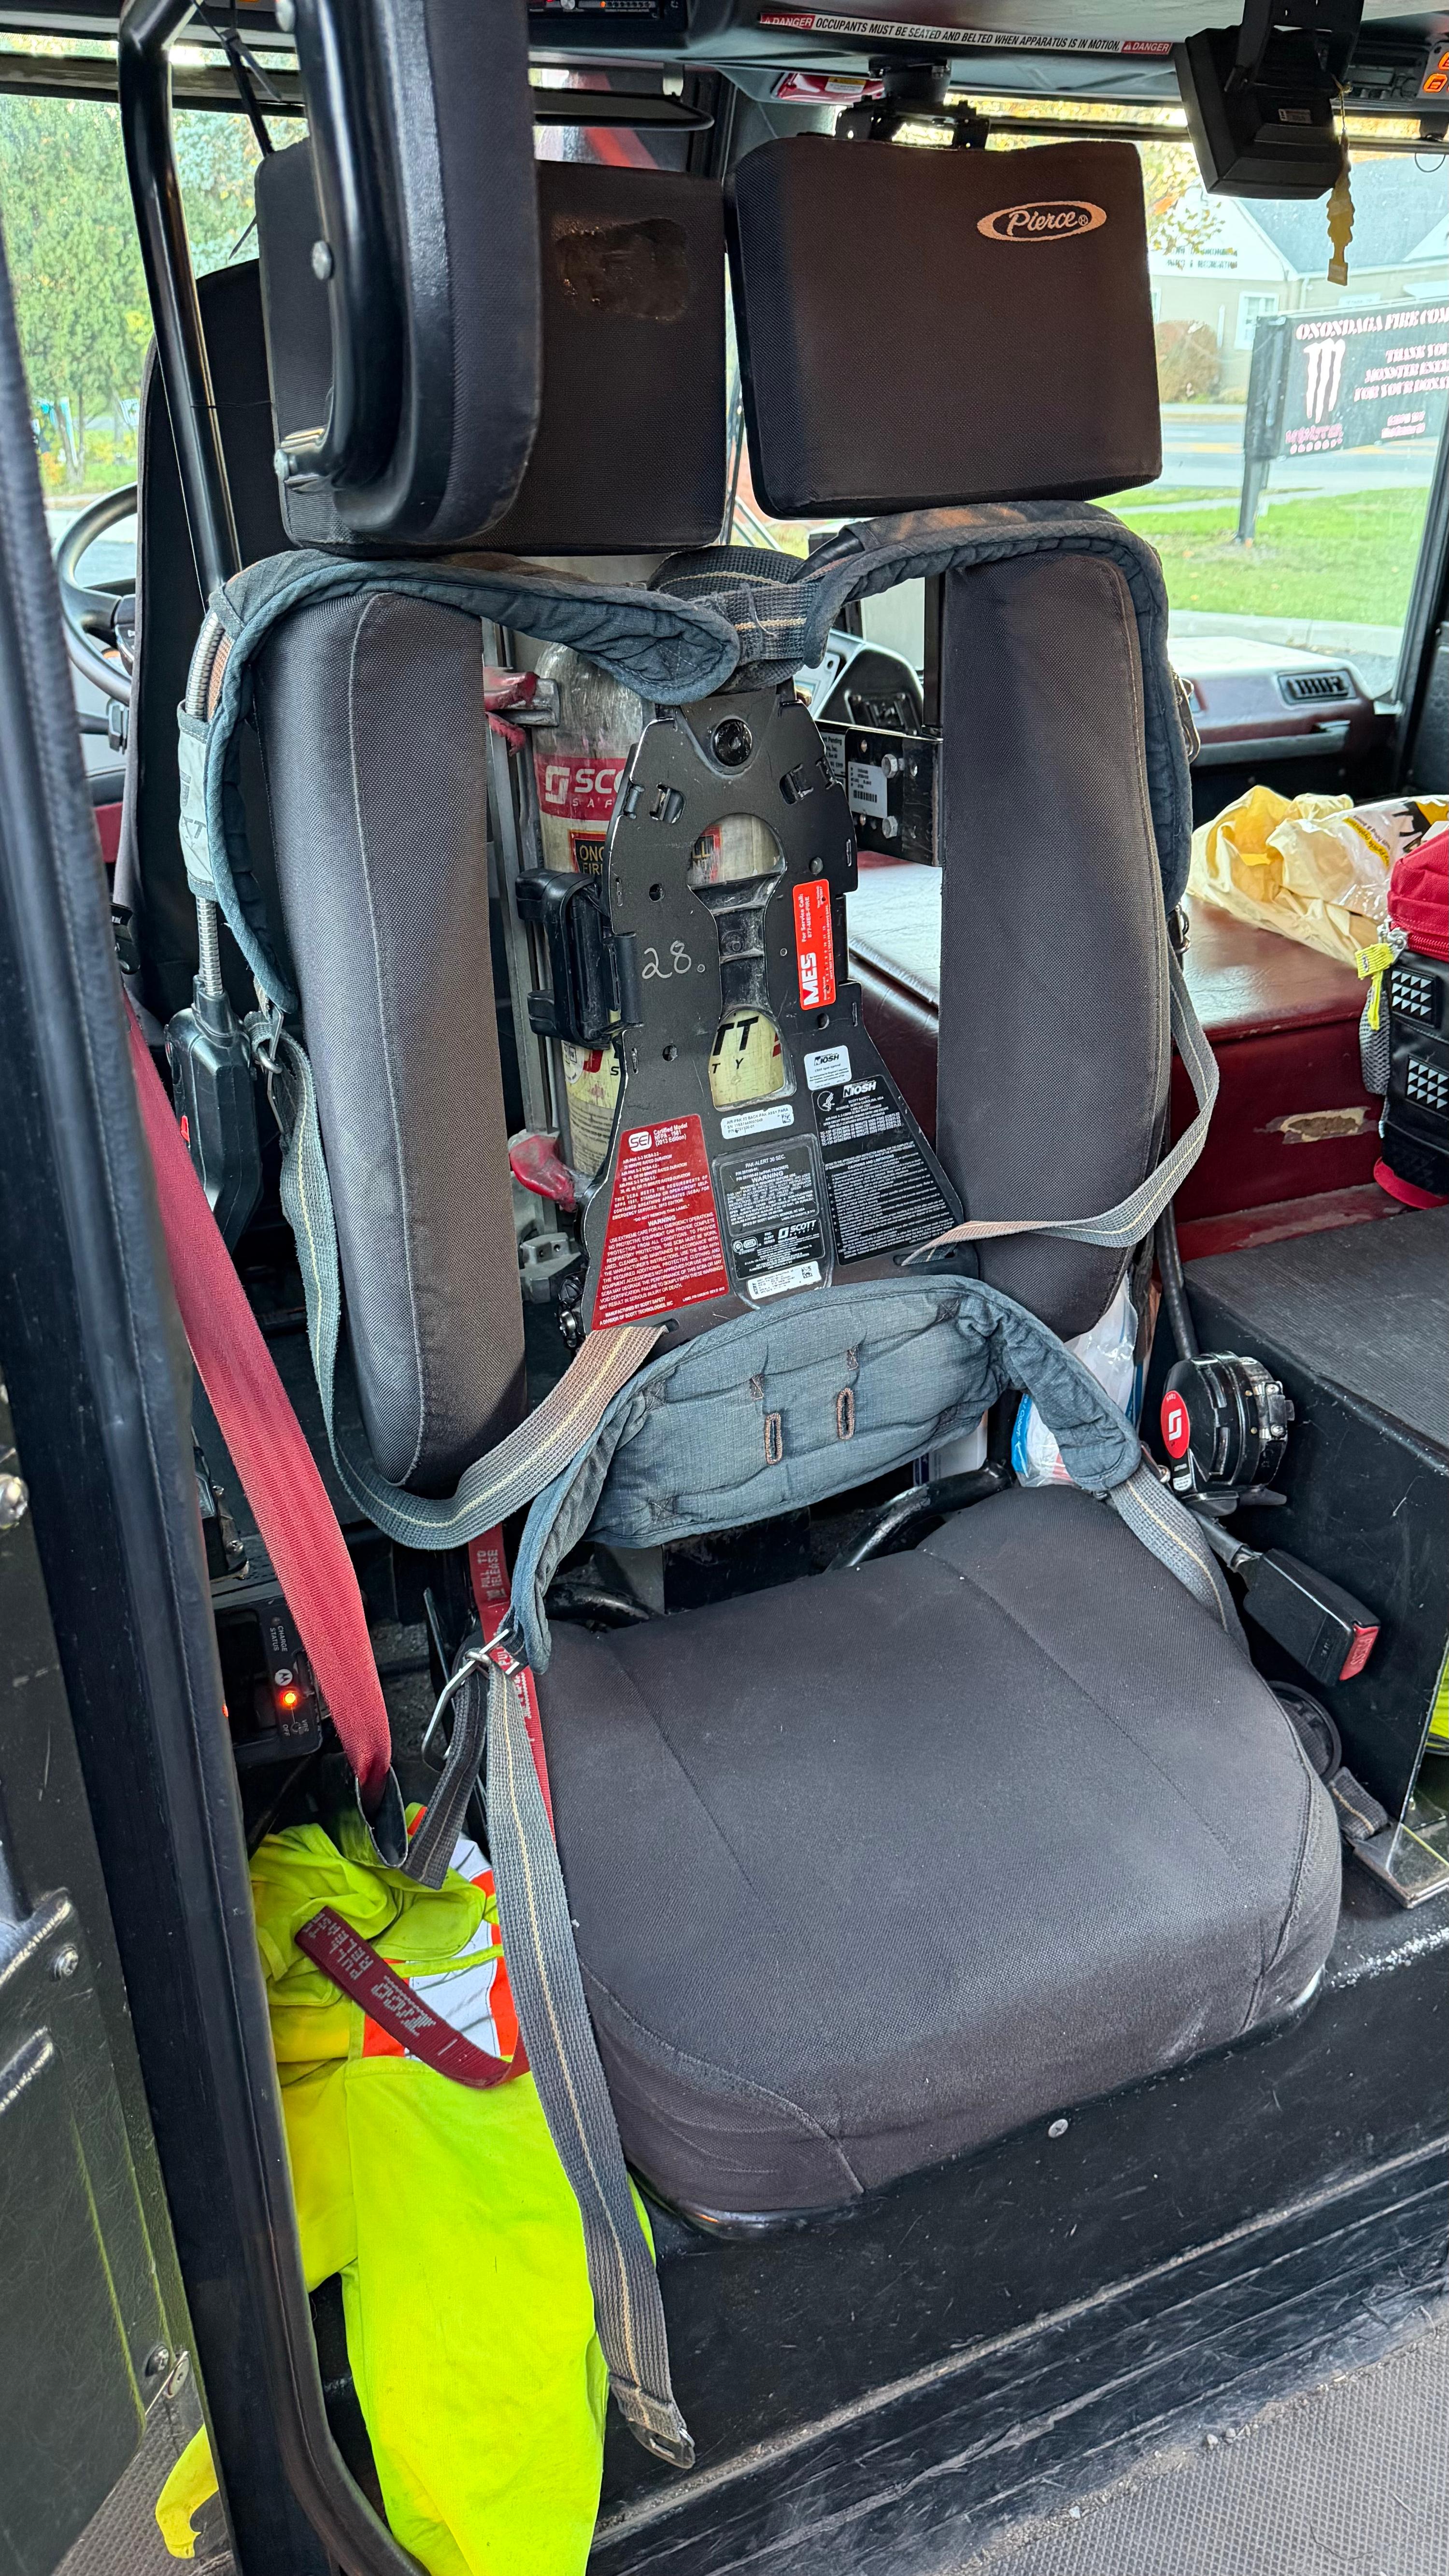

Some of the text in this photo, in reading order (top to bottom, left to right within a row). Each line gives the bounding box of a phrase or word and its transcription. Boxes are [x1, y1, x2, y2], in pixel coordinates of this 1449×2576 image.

[772, 17, 811, 27] DANGER
[816, 18, 867, 32] OCCUPANTS
[868, 24, 894, 35] MUST
[895, 26, 907, 36] BE
[908, 27, 941, 39] SEATED
[942, 31, 960, 41] AND
[961, 33, 993, 43] BELTED
[994, 35, 1018, 44] WHEN
[1019, 36, 1068, 47] APPARATUS
[1068, 39, 1076, 47] IS
[1079, 39, 1087, 48] IN
[1130, 40, 1169, 53] DANGER
[1296, 316, 1383, 340] ONONDAGA
[1385, 311, 1420, 330] FIRE
[800, 953, 819, 1006] MES
[843, 1081, 876, 1097] NIOSH
[673, 1122, 688, 1130] Model
[752, 1171, 783, 1183] WARNING
[648, 1215, 676, 1226] WARNING
[790, 1220, 816, 1233] SCOTT
[270, 1627, 279, 1651] STATUS
[278, 1625, 287, 1652] CHARGE
[329, 1936, 364, 1980] PULL
